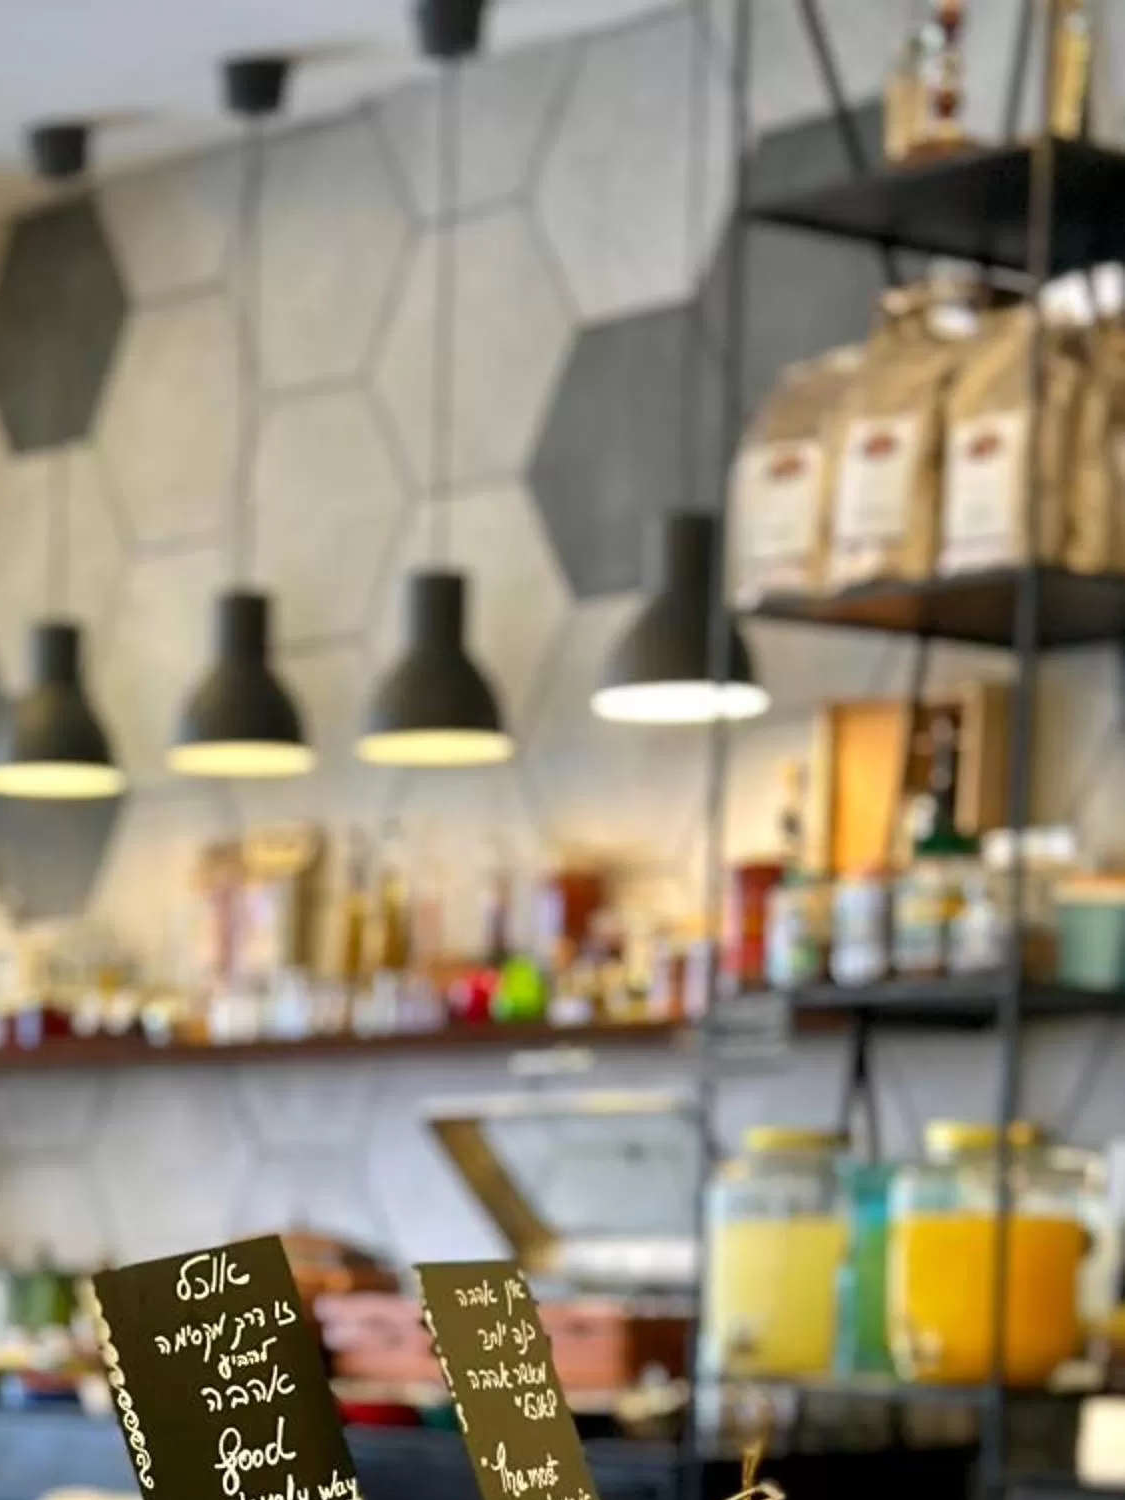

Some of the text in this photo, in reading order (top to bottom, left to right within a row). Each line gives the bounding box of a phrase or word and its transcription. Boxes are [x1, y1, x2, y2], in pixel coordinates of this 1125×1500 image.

[154, 1311, 226, 1363] מקסימה
[230, 1307, 266, 1350] דרך
[200, 1363, 296, 1413] אהבה
